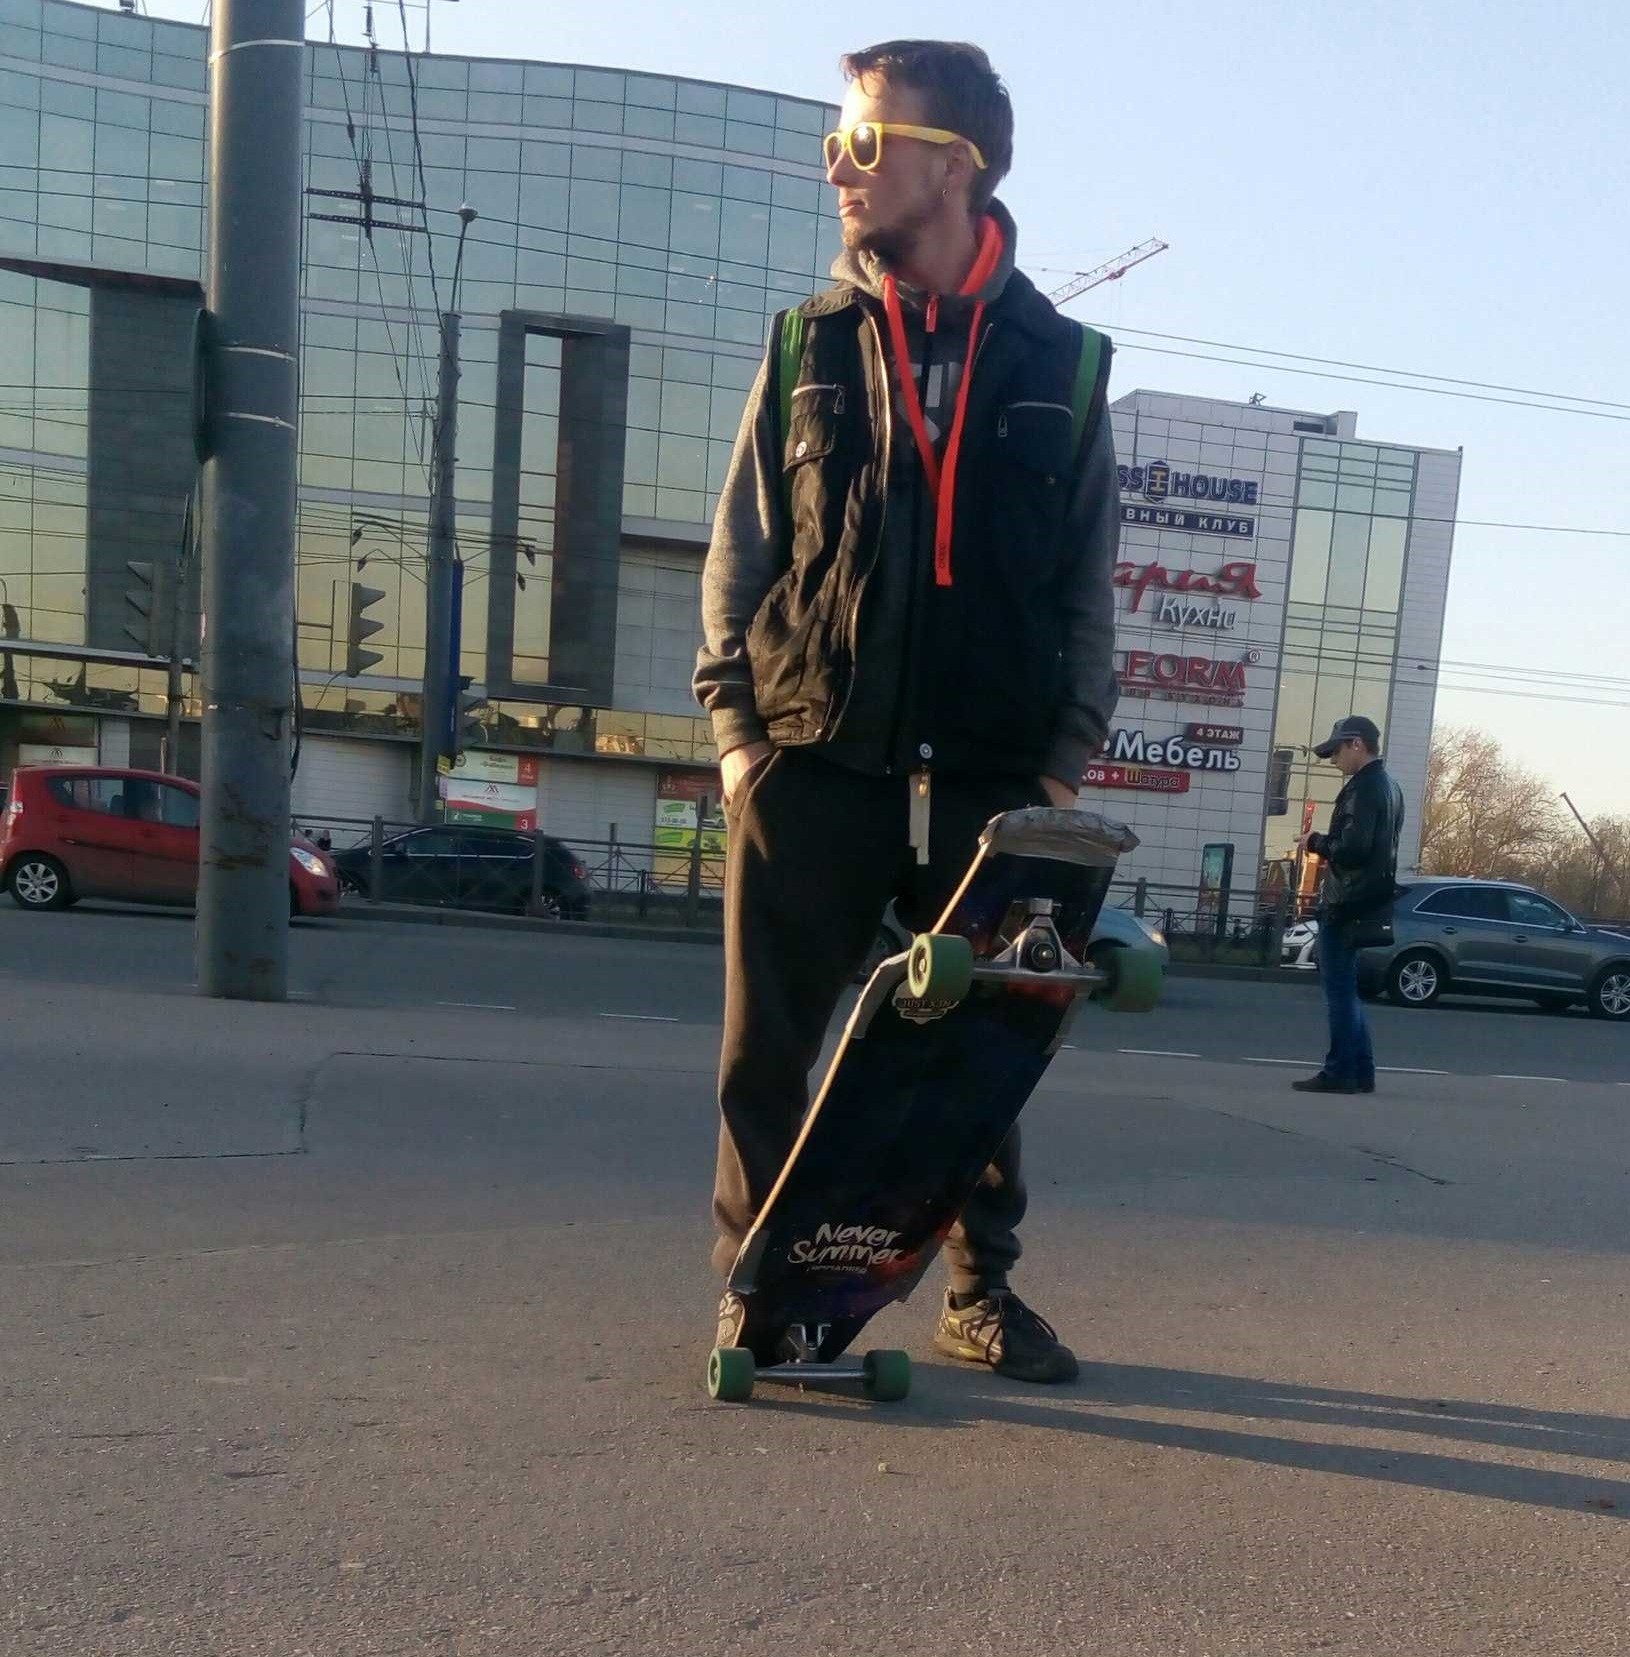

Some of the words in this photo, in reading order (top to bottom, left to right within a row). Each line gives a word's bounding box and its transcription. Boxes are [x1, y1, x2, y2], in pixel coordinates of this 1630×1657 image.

[1171, 471, 1258, 505] HOUSE
[1199, 518, 1248, 533] КЛУБ
[1159, 594, 1237, 631] Кухни
[1118, 650, 1247, 689] FORM
[1196, 727, 1204, 736] 4
[1206, 727, 1240, 740] ЭТАЖ
[1082, 769, 1105, 781] ОВ
[520, 819, 529, 830] 3
[815, 1222, 904, 1247] Never
[786, 1240, 904, 1266] Summer
